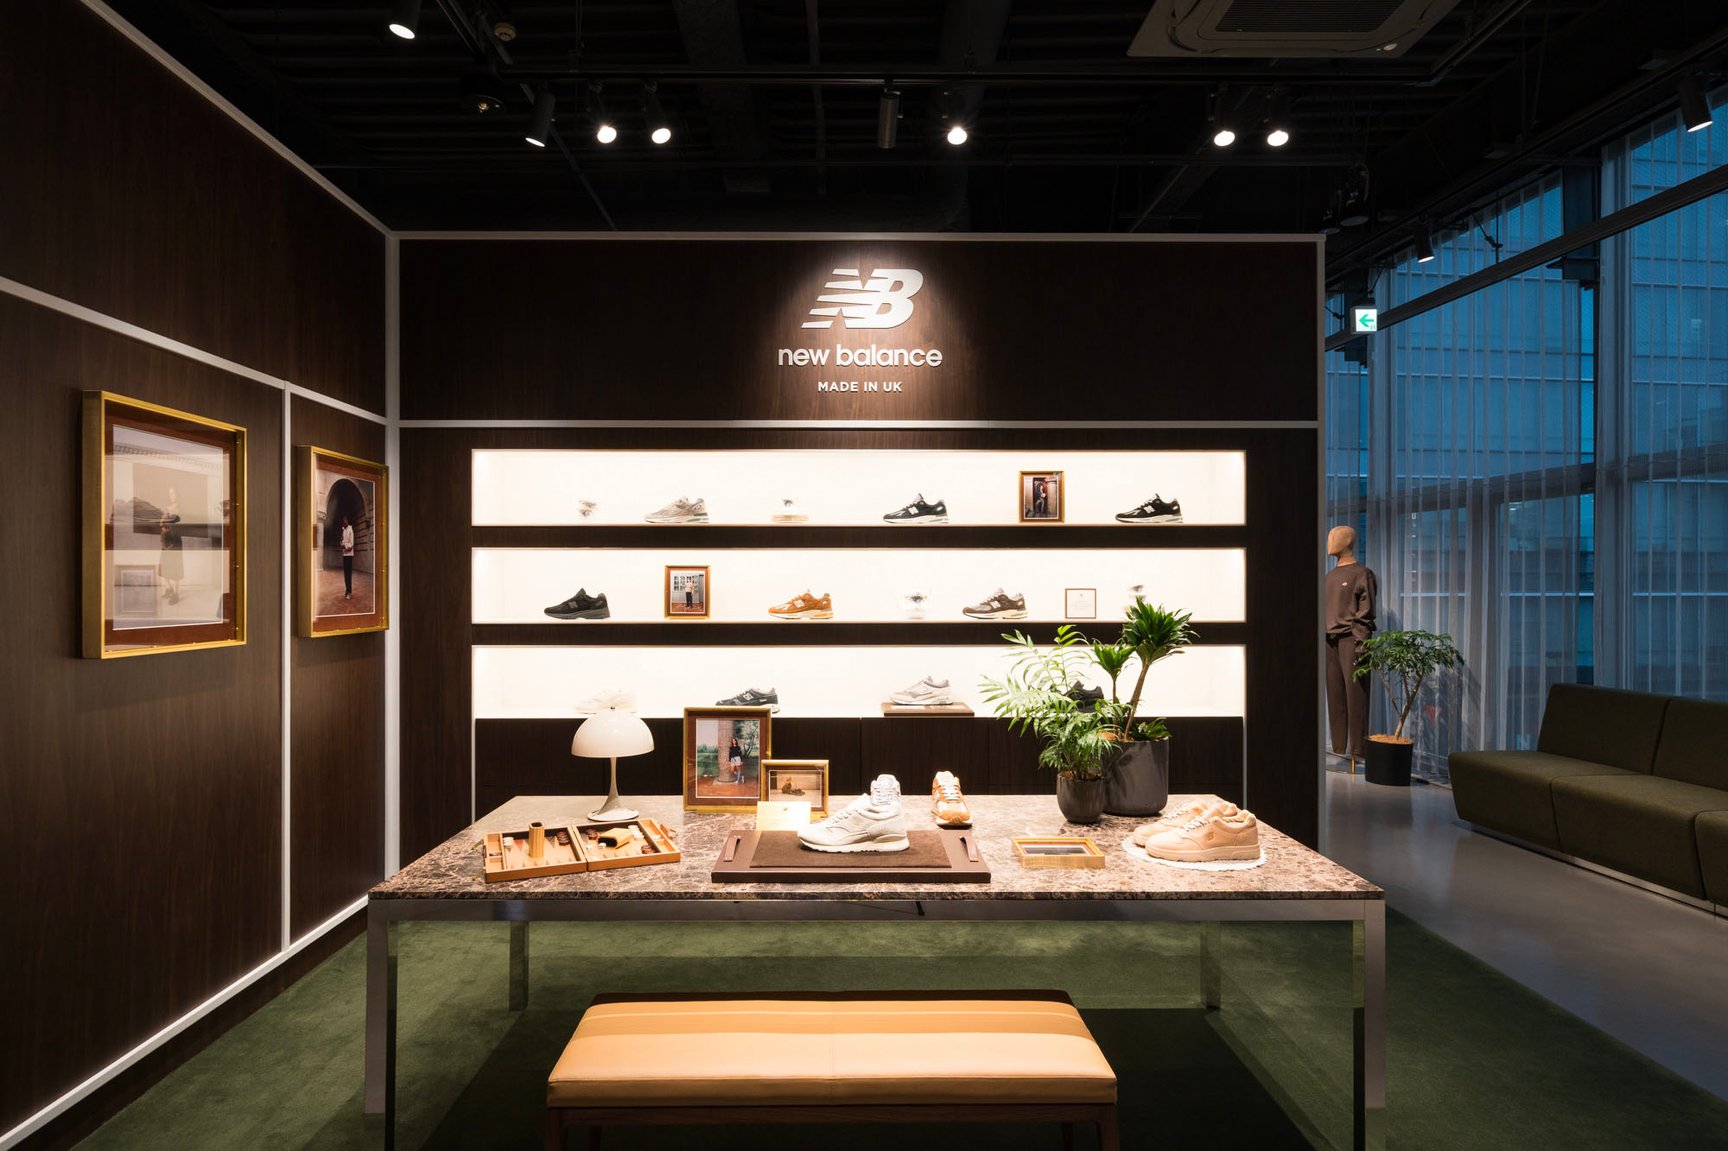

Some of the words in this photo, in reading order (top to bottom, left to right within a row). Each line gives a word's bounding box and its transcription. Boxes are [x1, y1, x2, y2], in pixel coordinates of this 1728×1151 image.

[778, 348, 830, 366] new
[836, 344, 943, 367] balance
[818, 381, 859, 392] MADE
[864, 381, 878, 392] IN
[883, 381, 903, 392] UK
